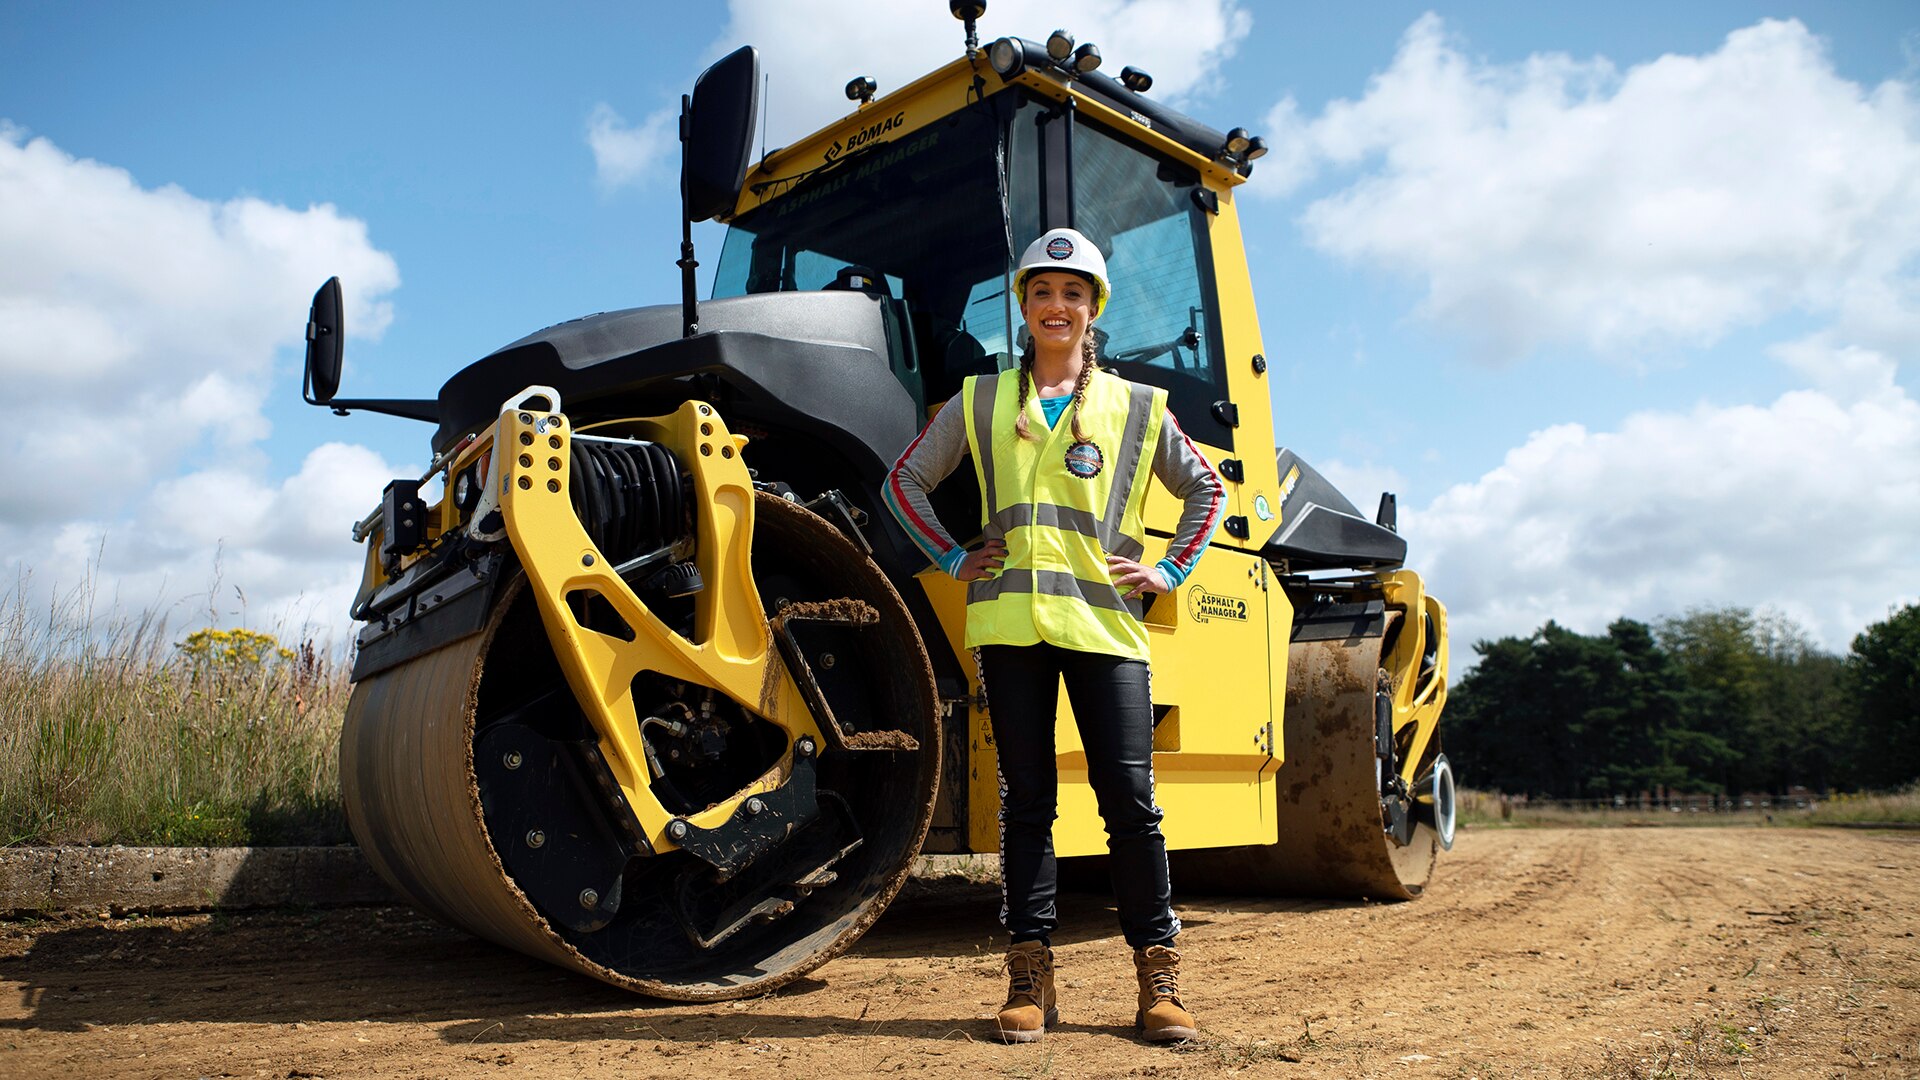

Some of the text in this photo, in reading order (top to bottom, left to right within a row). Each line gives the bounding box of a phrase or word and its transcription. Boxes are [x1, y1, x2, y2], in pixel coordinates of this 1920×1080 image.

[846, 112, 904, 151] BOMAG
[777, 132, 939, 217] ASPHALT MANAGER
[1201, 595, 1246, 620] ASPHALT 2
[1201, 605, 1237, 618] MANAGER
